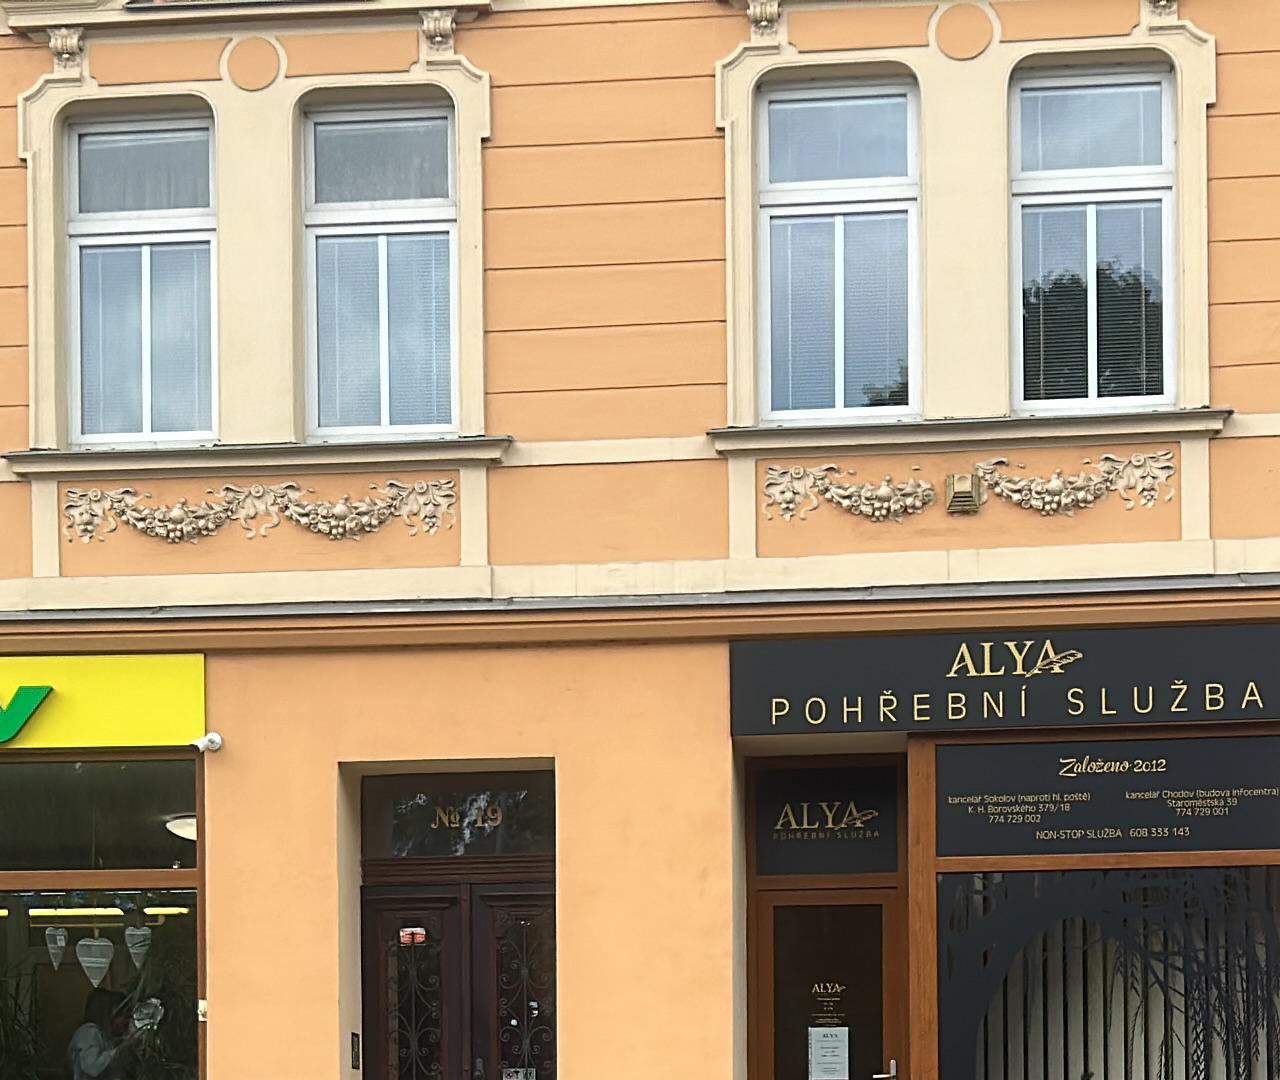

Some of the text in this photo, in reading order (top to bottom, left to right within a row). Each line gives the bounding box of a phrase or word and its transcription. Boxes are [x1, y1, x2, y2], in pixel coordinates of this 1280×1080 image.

[946, 639, 1065, 678] ALYA
[771, 680, 1264, 726] POHŘEBNÍ SLUŽBA
[1058, 755, 1167, 777] Založeno 2012
[983, 794, 1016, 803] Sokolov
[1017, 792, 1051, 803] (naproti
[1161, 788, 1195, 799] Chodov
[1196, 788, 1231, 799] (budova
[1232, 786, 1280, 798] infocentra)
[773, 800, 864, 829] ALYA
[1175, 808, 1192, 816] 774
[1194, 808, 1211, 816] 729
[1007, 815, 1023, 823] 729
[1035, 830, 1084, 840] NON-STOP
[1087, 827, 1122, 838] SLUŽBA
[1173, 826, 1190, 836] 143
[812, 983, 841, 993] ALYA
